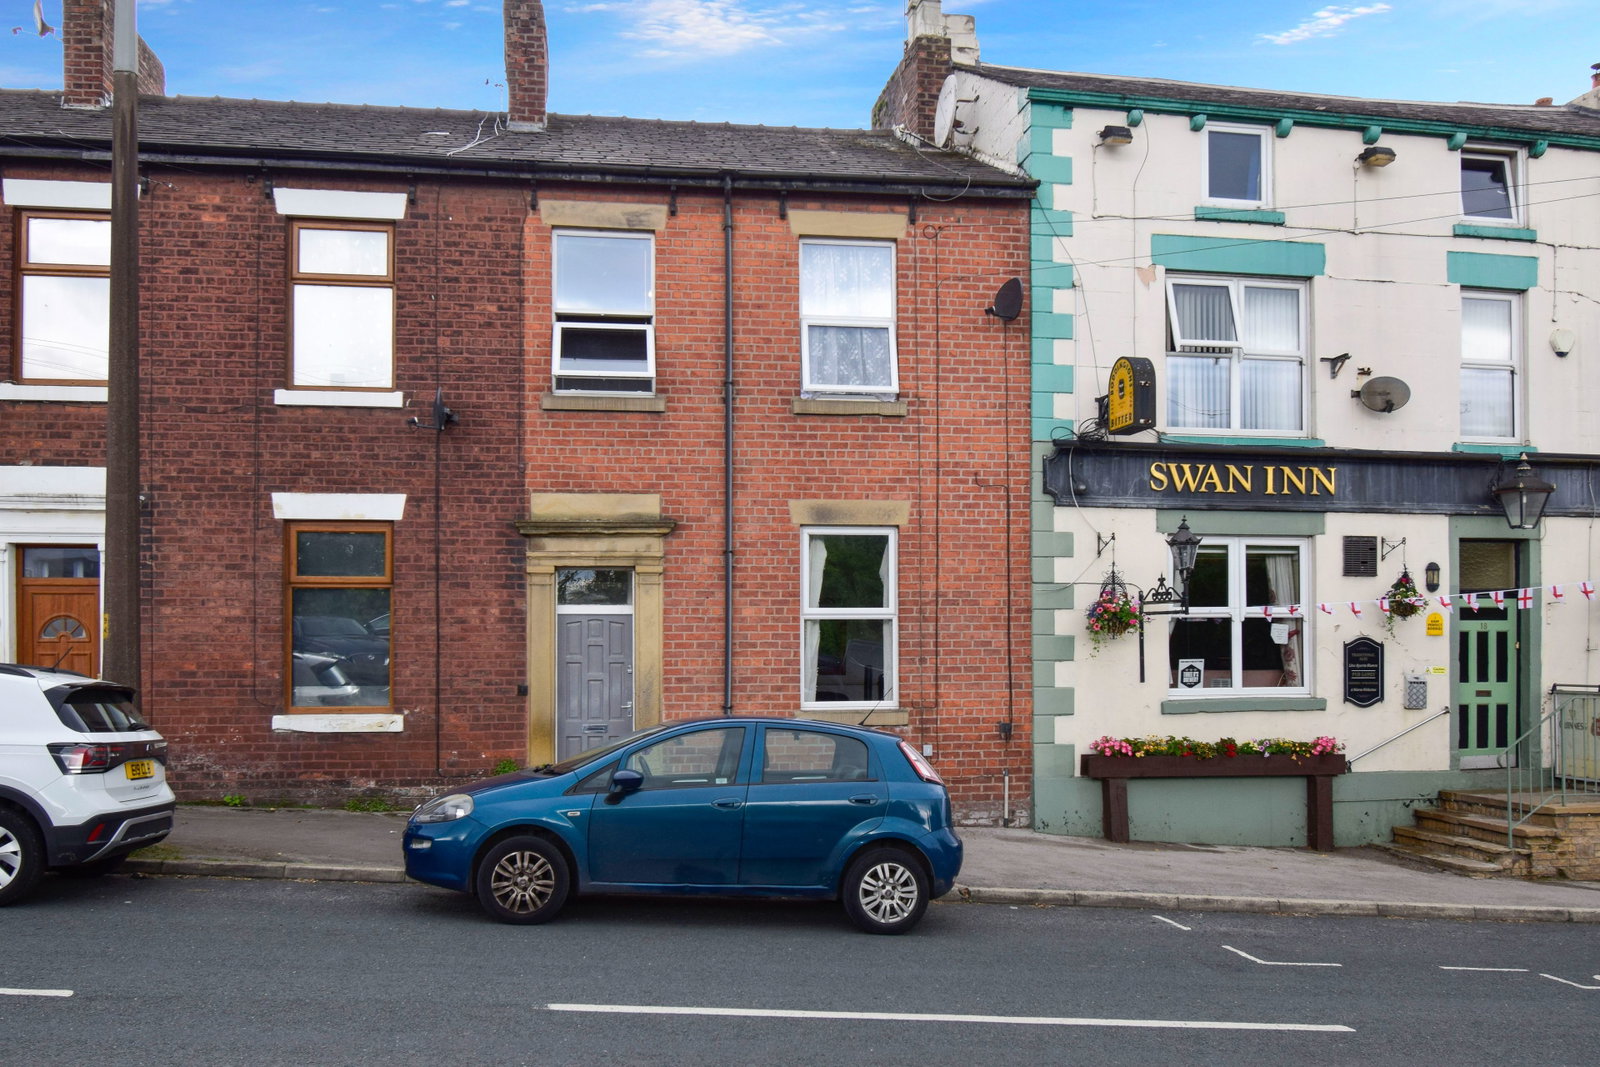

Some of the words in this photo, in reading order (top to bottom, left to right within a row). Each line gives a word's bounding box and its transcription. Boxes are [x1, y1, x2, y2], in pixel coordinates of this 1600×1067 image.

[1110, 412, 1133, 428] BITTER
[1150, 461, 1254, 494] SWAN
[1263, 465, 1338, 496] INN
